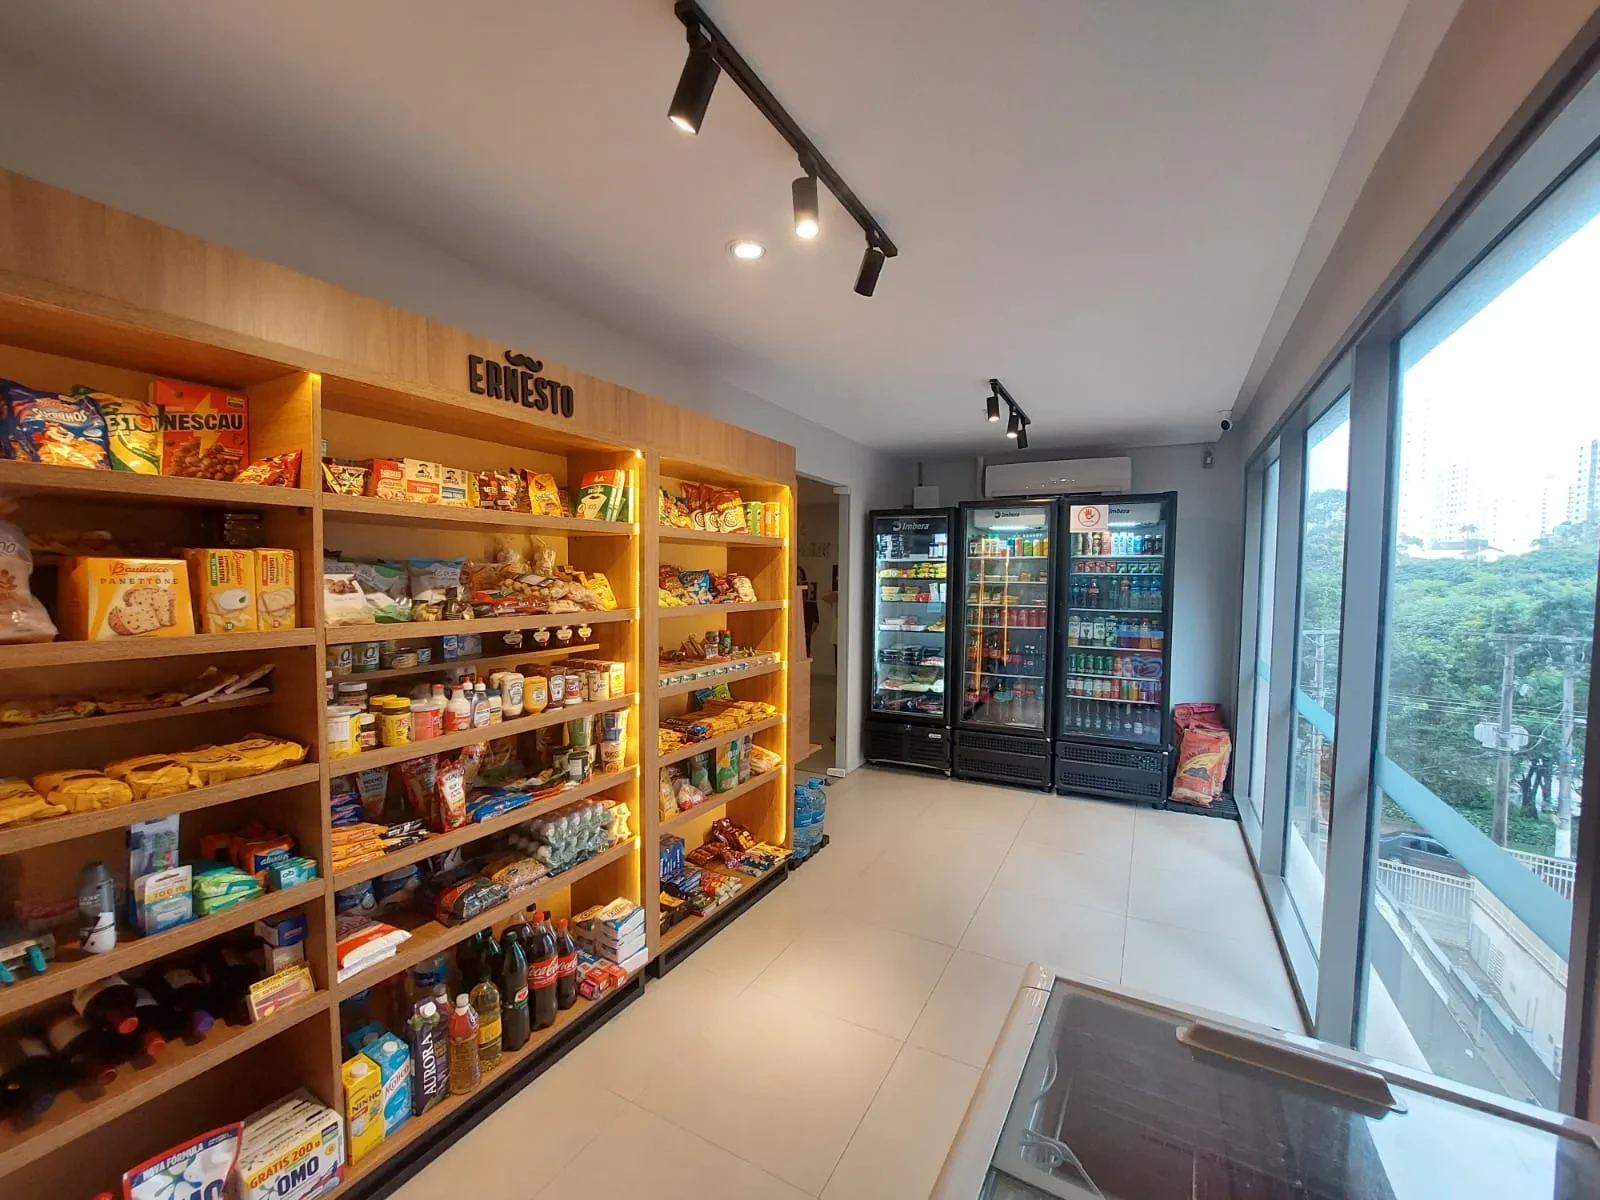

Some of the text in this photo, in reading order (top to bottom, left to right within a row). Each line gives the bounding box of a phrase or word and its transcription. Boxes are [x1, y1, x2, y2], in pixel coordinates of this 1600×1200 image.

[468, 354, 575, 418] ERNESTO
[163, 412, 243, 431] NESCAU
[902, 522, 930, 531] Imbera
[421, 1031, 437, 1095] AURORA
[351, 1089, 382, 1113] NINHO
[250, 1156, 290, 1189] GRATIS
[291, 1142, 313, 1162] 200
[277, 1155, 319, 1197] OMO
